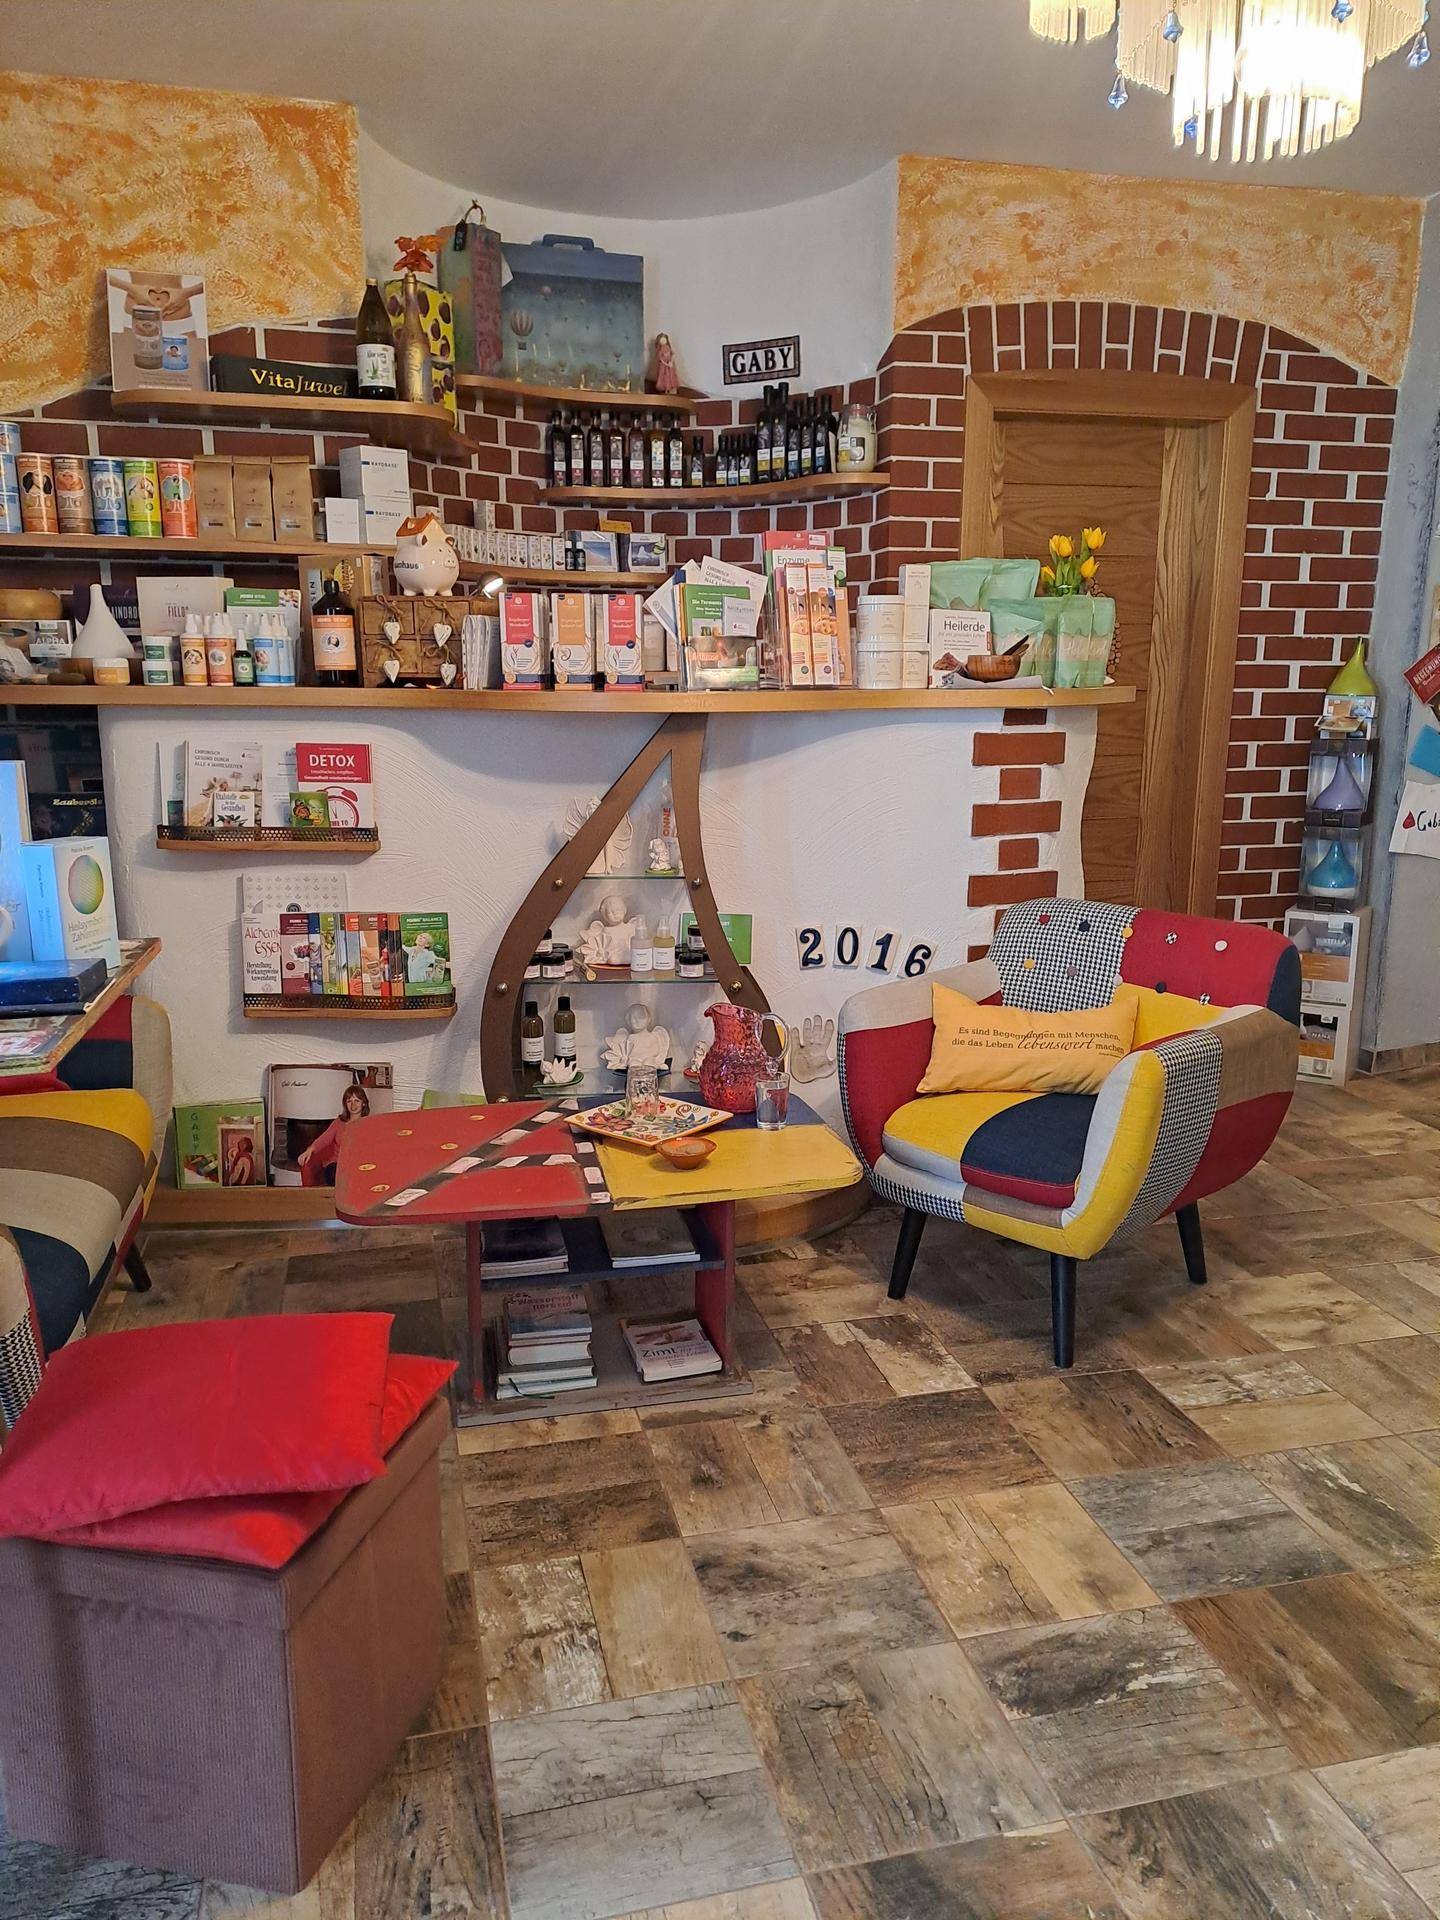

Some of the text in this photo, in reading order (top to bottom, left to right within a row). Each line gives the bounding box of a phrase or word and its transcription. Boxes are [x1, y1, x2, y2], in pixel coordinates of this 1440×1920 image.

[731, 347, 792, 374] GABY
[944, 620, 985, 632] Heilerde
[309, 754, 355, 768] DETOX
[800, 927, 932, 977] 2016
[959, 1027, 969, 1035] Es
[971, 1028, 990, 1036] sind
[1075, 1031, 1121, 1042] Menschen,
[952, 1031, 1125, 1054] die das Leben lebenswert machen
[640, 1347, 677, 1358] Zimt
